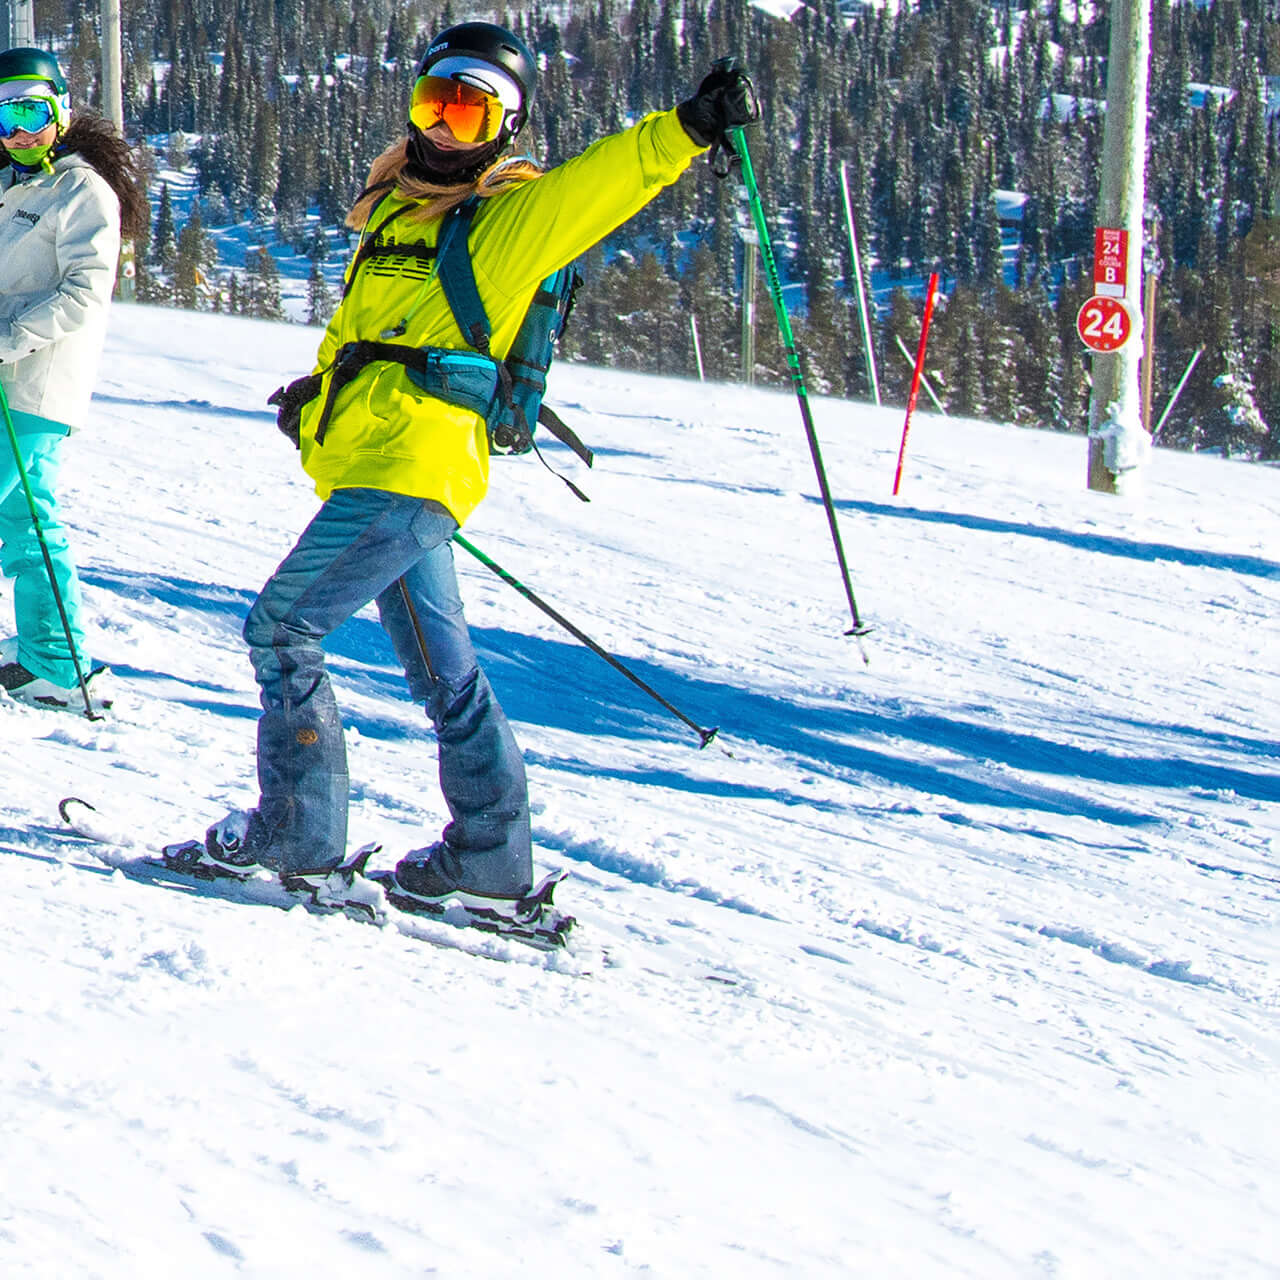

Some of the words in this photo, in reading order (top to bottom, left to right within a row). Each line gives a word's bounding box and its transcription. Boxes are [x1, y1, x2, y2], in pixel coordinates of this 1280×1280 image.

[1102, 241, 1120, 255] 24
[1105, 266, 1116, 282] B
[1083, 308, 1124, 340] 24
